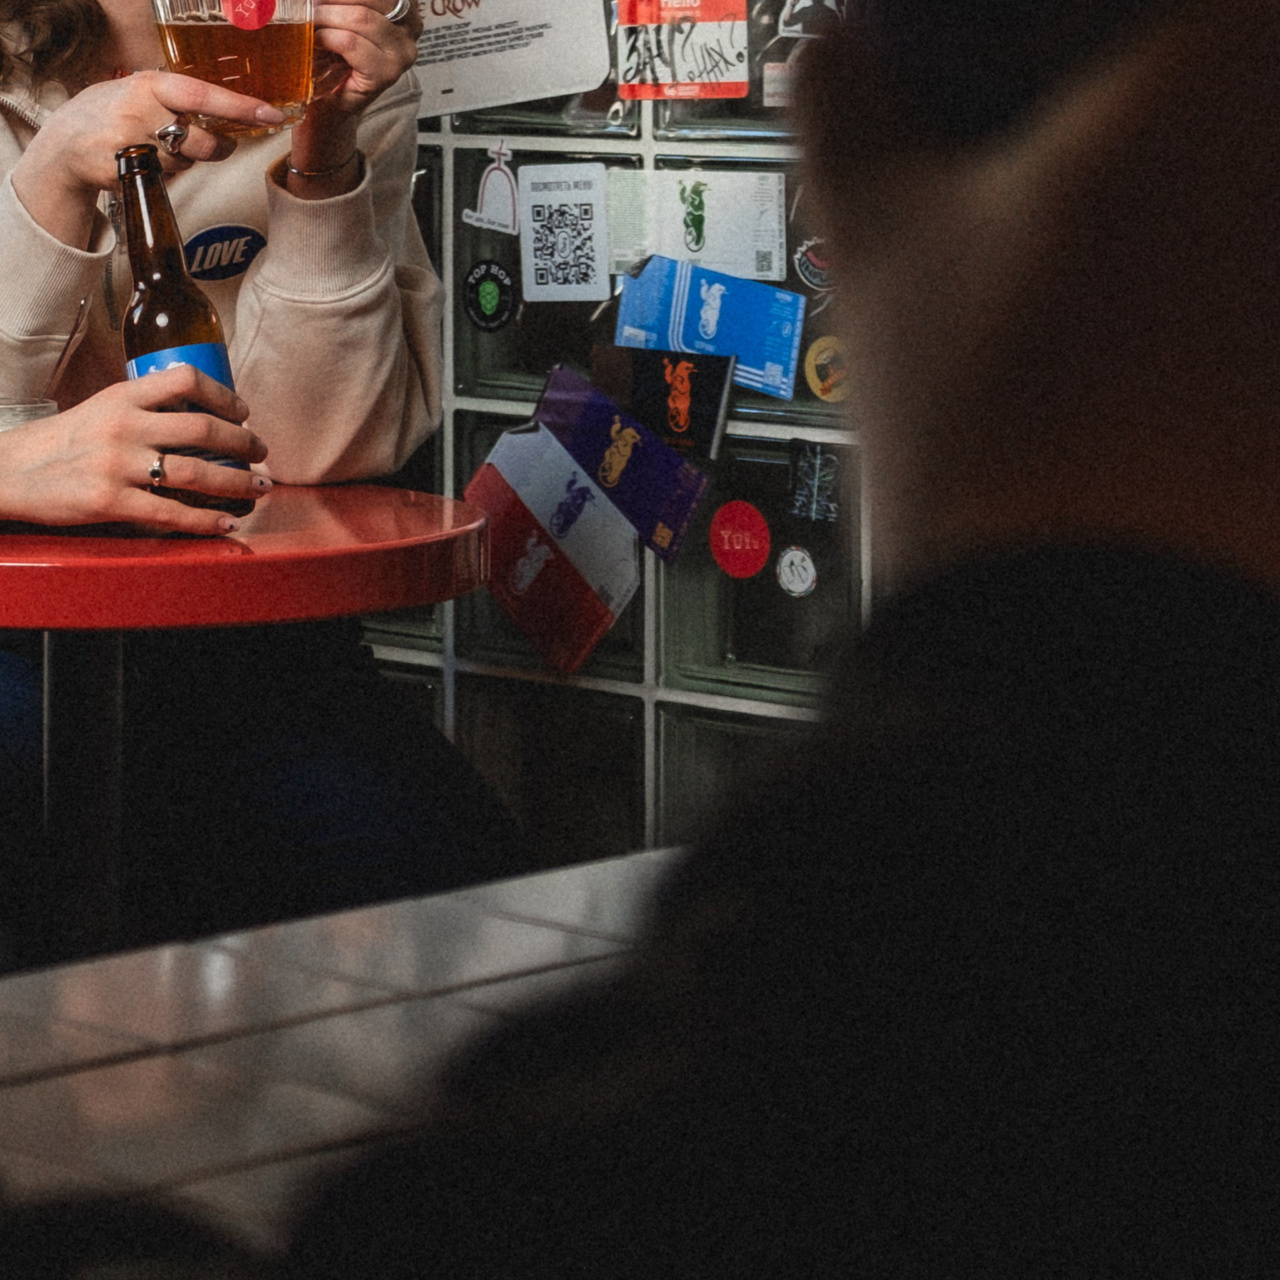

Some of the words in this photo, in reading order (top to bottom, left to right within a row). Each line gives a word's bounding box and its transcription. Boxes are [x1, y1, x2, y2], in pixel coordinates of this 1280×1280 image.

[189, 235, 253, 274] LOVE
[468, 264, 488, 284] TOP
[490, 264, 512, 286] HOP
